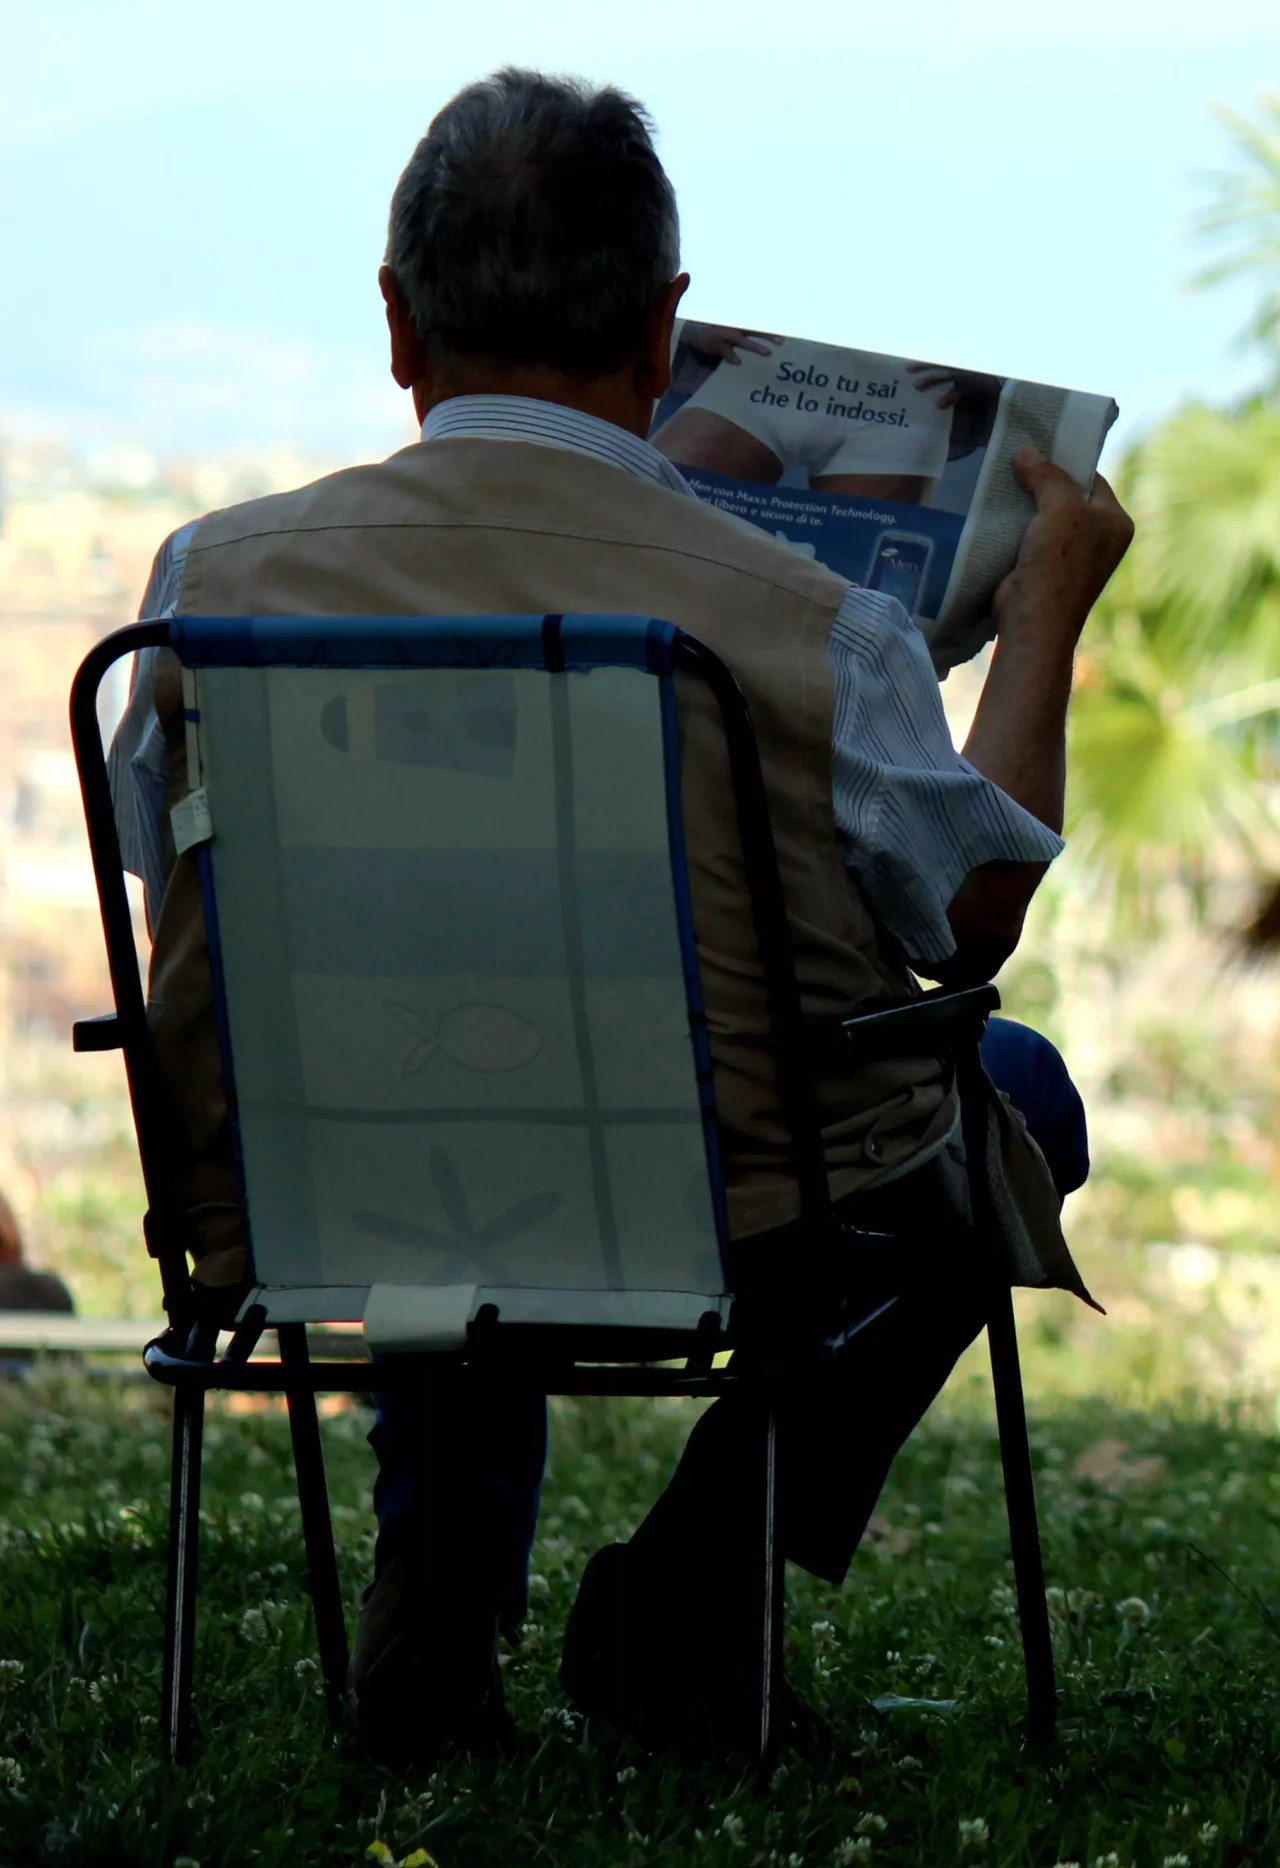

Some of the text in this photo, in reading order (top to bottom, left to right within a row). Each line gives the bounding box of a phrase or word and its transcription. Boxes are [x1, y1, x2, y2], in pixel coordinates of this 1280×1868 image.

[776, 361, 899, 399] Solo tu sai
[749, 385, 909, 428] che lo indossi.
[713, 486, 734, 498] con
[736, 489, 767, 506] Maxx
[770, 496, 828, 514] Protection
[830, 504, 897, 525] Technology.
[749, 508, 759, 516] e
[760, 509, 794, 522] sicuro
[796, 513, 808, 523] di
[809, 516, 825, 526] te.
